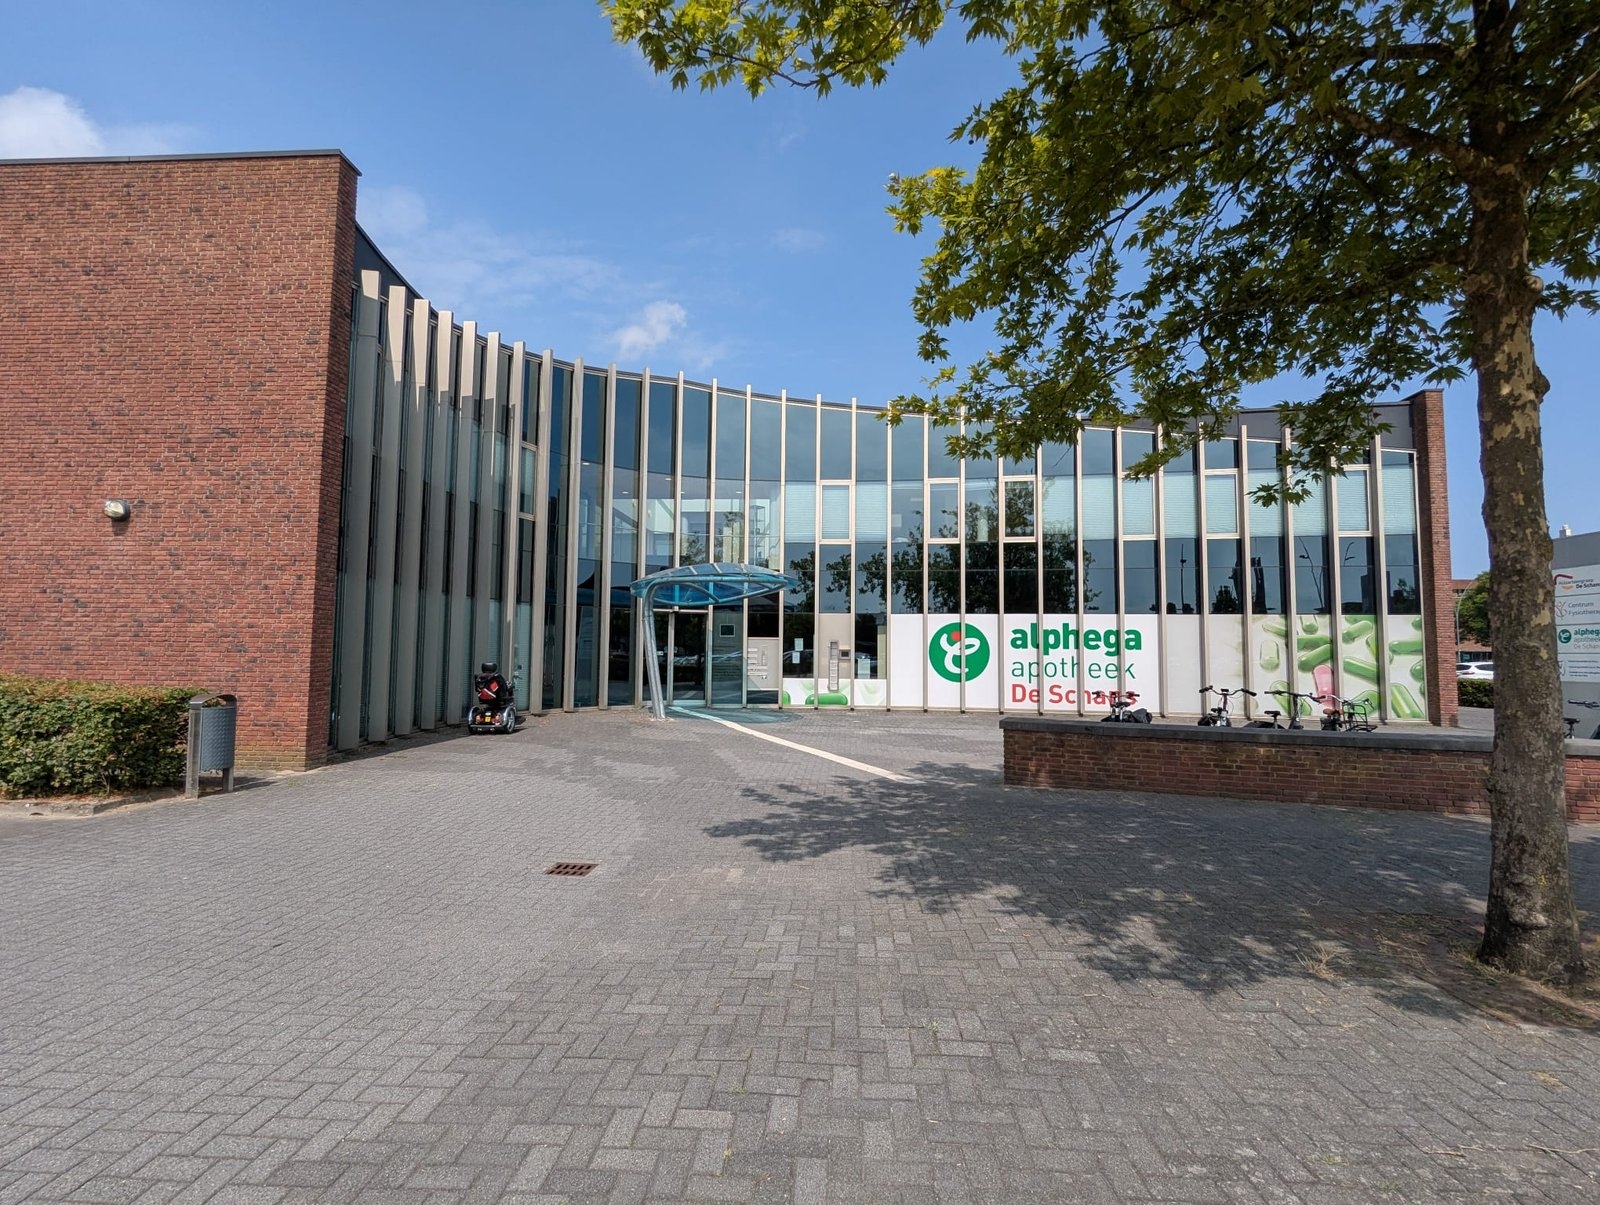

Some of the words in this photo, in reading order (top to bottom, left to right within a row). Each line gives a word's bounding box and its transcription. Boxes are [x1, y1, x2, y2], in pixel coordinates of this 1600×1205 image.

[1010, 623, 1142, 657] alphega
[1574, 628, 1600, 637] alpheg
[1012, 684, 1040, 703] De
